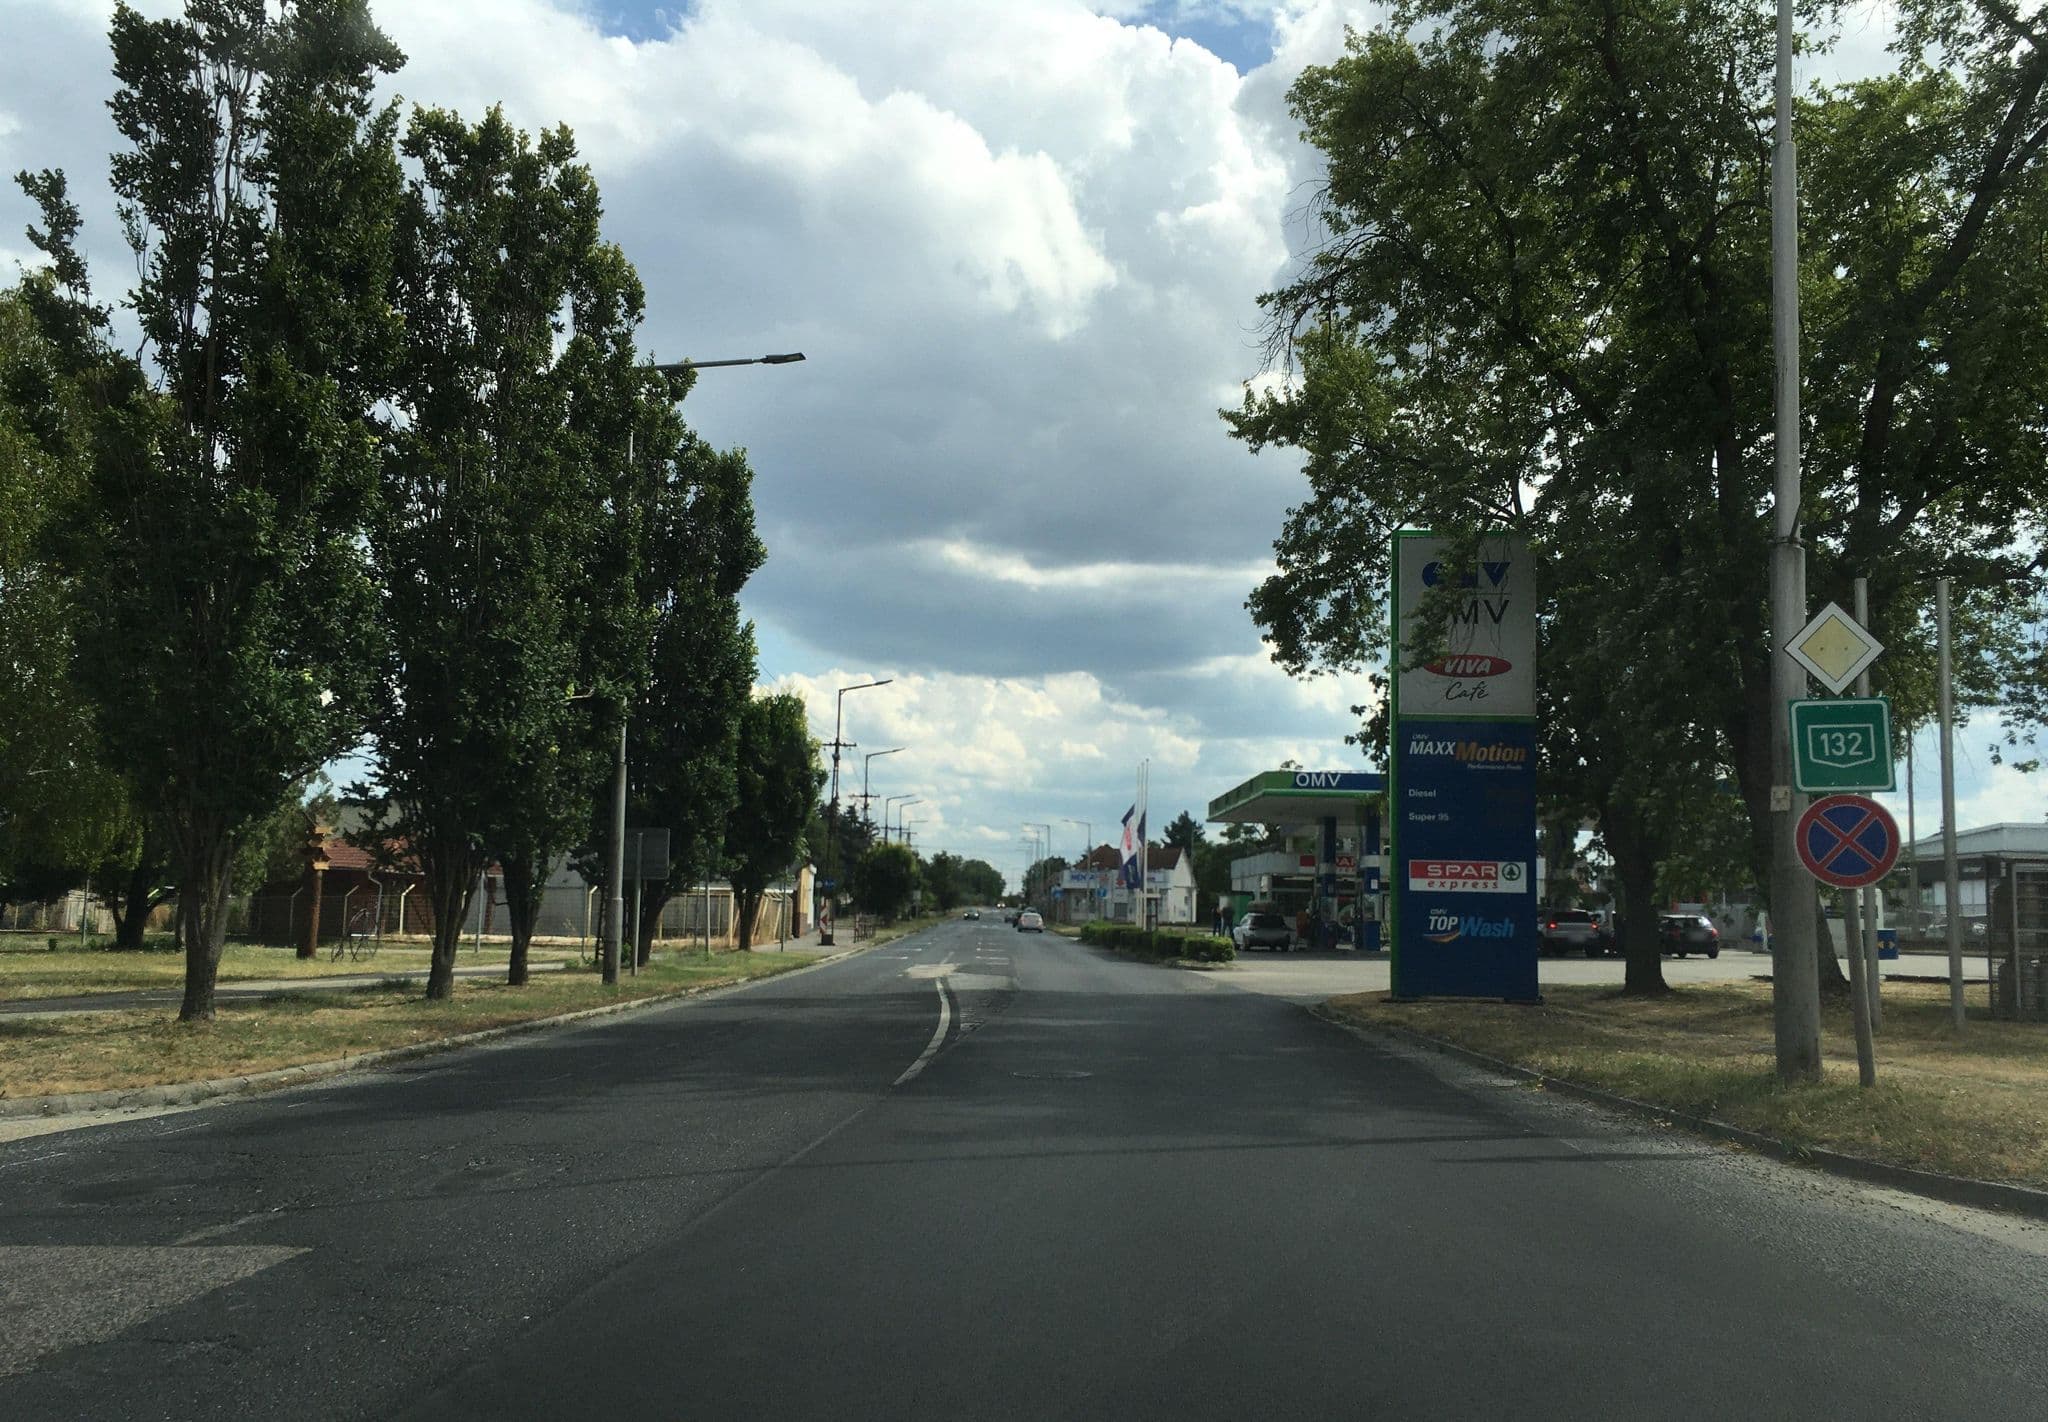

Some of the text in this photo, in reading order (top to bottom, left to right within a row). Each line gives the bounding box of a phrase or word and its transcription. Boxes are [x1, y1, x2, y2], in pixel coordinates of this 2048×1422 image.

[1444, 658, 1492, 673] VIVA
[1820, 732, 1863, 756] 132
[1296, 773, 1342, 787] OMV
[1408, 789, 1437, 798] Diesel
[1408, 813, 1436, 822] Super
[1427, 864, 1497, 877] SPAR
[1427, 880, 1498, 890] express
